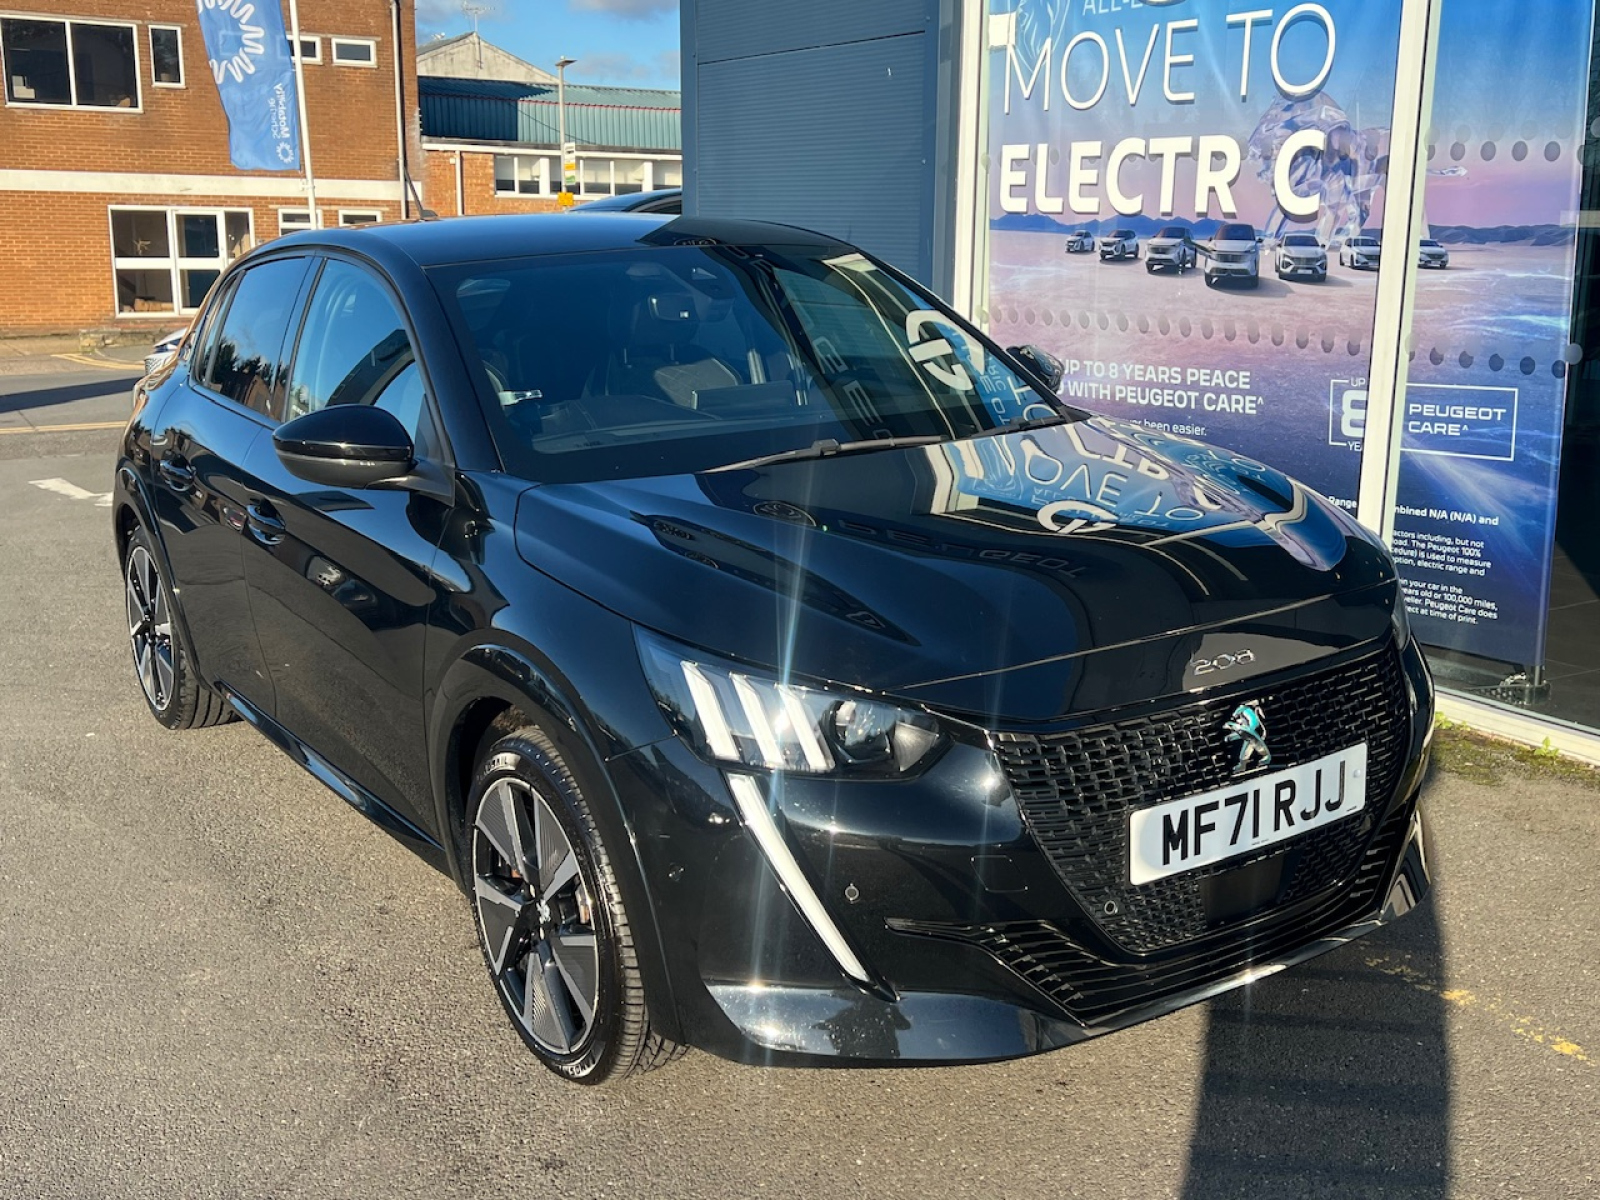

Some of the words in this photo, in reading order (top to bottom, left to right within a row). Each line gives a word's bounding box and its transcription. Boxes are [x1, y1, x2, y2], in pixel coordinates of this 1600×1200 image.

[1003, 18, 1199, 115] MOVE
[1226, 3, 1336, 98] TO
[1083, 360, 1105, 377] TO
[1109, 362, 1119, 379] 8
[1123, 364, 1182, 384] YEARS
[1186, 368, 1251, 390] PEACE
[1350, 376, 1366, 387] UP
[1068, 379, 1111, 401] WITH
[1115, 384, 1199, 410] PEUGEOT
[1408, 403, 1507, 421] PEUGEOT
[1172, 423, 1207, 436] easier.
[1429, 508, 1448, 520] N/A
[1450, 511, 1477, 524] (N/A)
[1478, 515, 1499, 526] and
[1411, 539, 1426, 549] The
[1427, 541, 1460, 555] Peugeot
[1416, 532, 1454, 546] including,
[1455, 537, 1470, 546] but
[1470, 540, 1485, 549] not
[1426, 551, 1446, 562] used
[1446, 555, 1456, 563] to
[1456, 557, 1492, 569] measure
[1445, 563, 1468, 575] range
[1469, 567, 1486, 577] and
[1409, 580, 1427, 589] your
[1427, 583, 1441, 591] car
[1441, 583, 1449, 591] in
[1449, 585, 1463, 595] the
[1420, 589, 1432, 598] old
[1433, 592, 1442, 600] or
[1425, 598, 1457, 611] Peugeot
[1458, 603, 1477, 616] Care
[1477, 609, 1499, 620] does
[1429, 610, 1448, 620] time
[1192, 649, 1256, 676] 208
[1162, 788, 1261, 867] MF71
[1273, 759, 1346, 832] RJJ
